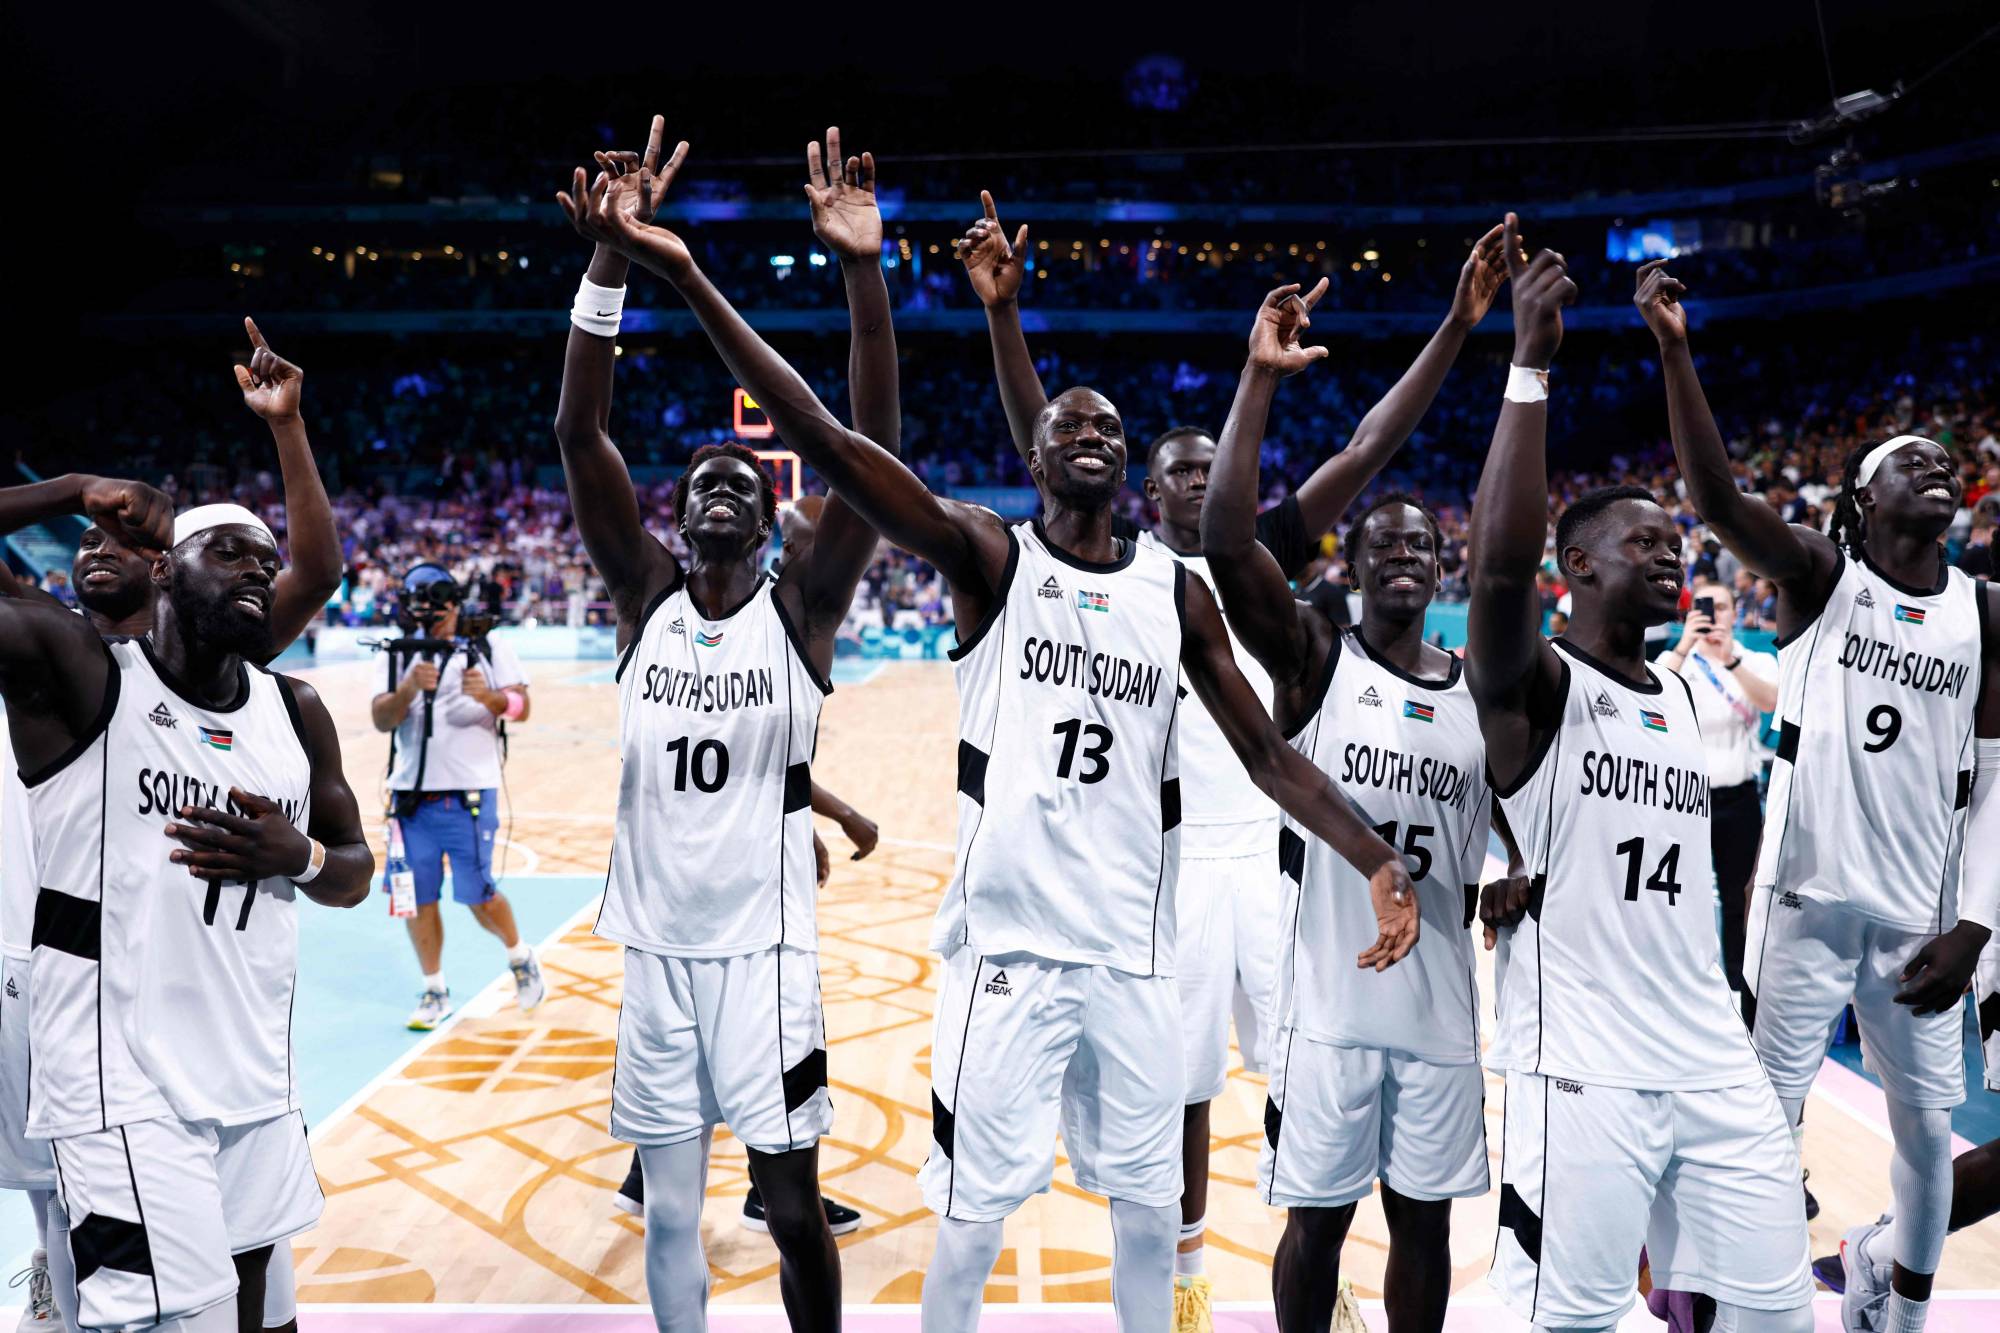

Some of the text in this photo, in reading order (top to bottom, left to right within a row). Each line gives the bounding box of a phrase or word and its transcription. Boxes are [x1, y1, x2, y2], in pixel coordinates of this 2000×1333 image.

[1038, 588, 1064, 600] PEAK
[642, 663, 774, 713] SOUTH SUDAN
[1088, 652, 1162, 708] SUDAN
[1900, 651, 1970, 700] SUDAN
[149, 712, 178, 729] PEAK
[1358, 696, 1383, 708] PEAK
[1593, 704, 1618, 719] PEAK
[1053, 718, 1114, 784] 13
[1863, 704, 1903, 754] 9
[666, 736, 730, 793] 10
[1341, 743, 1414, 794] SOUTH
[1580, 750, 1658, 807] SOUTH
[1615, 836, 1682, 907] 14
[1779, 897, 1803, 910] PEAK
[985, 983, 1013, 997] PEAK
[1556, 1080, 1584, 1096] PEAK
